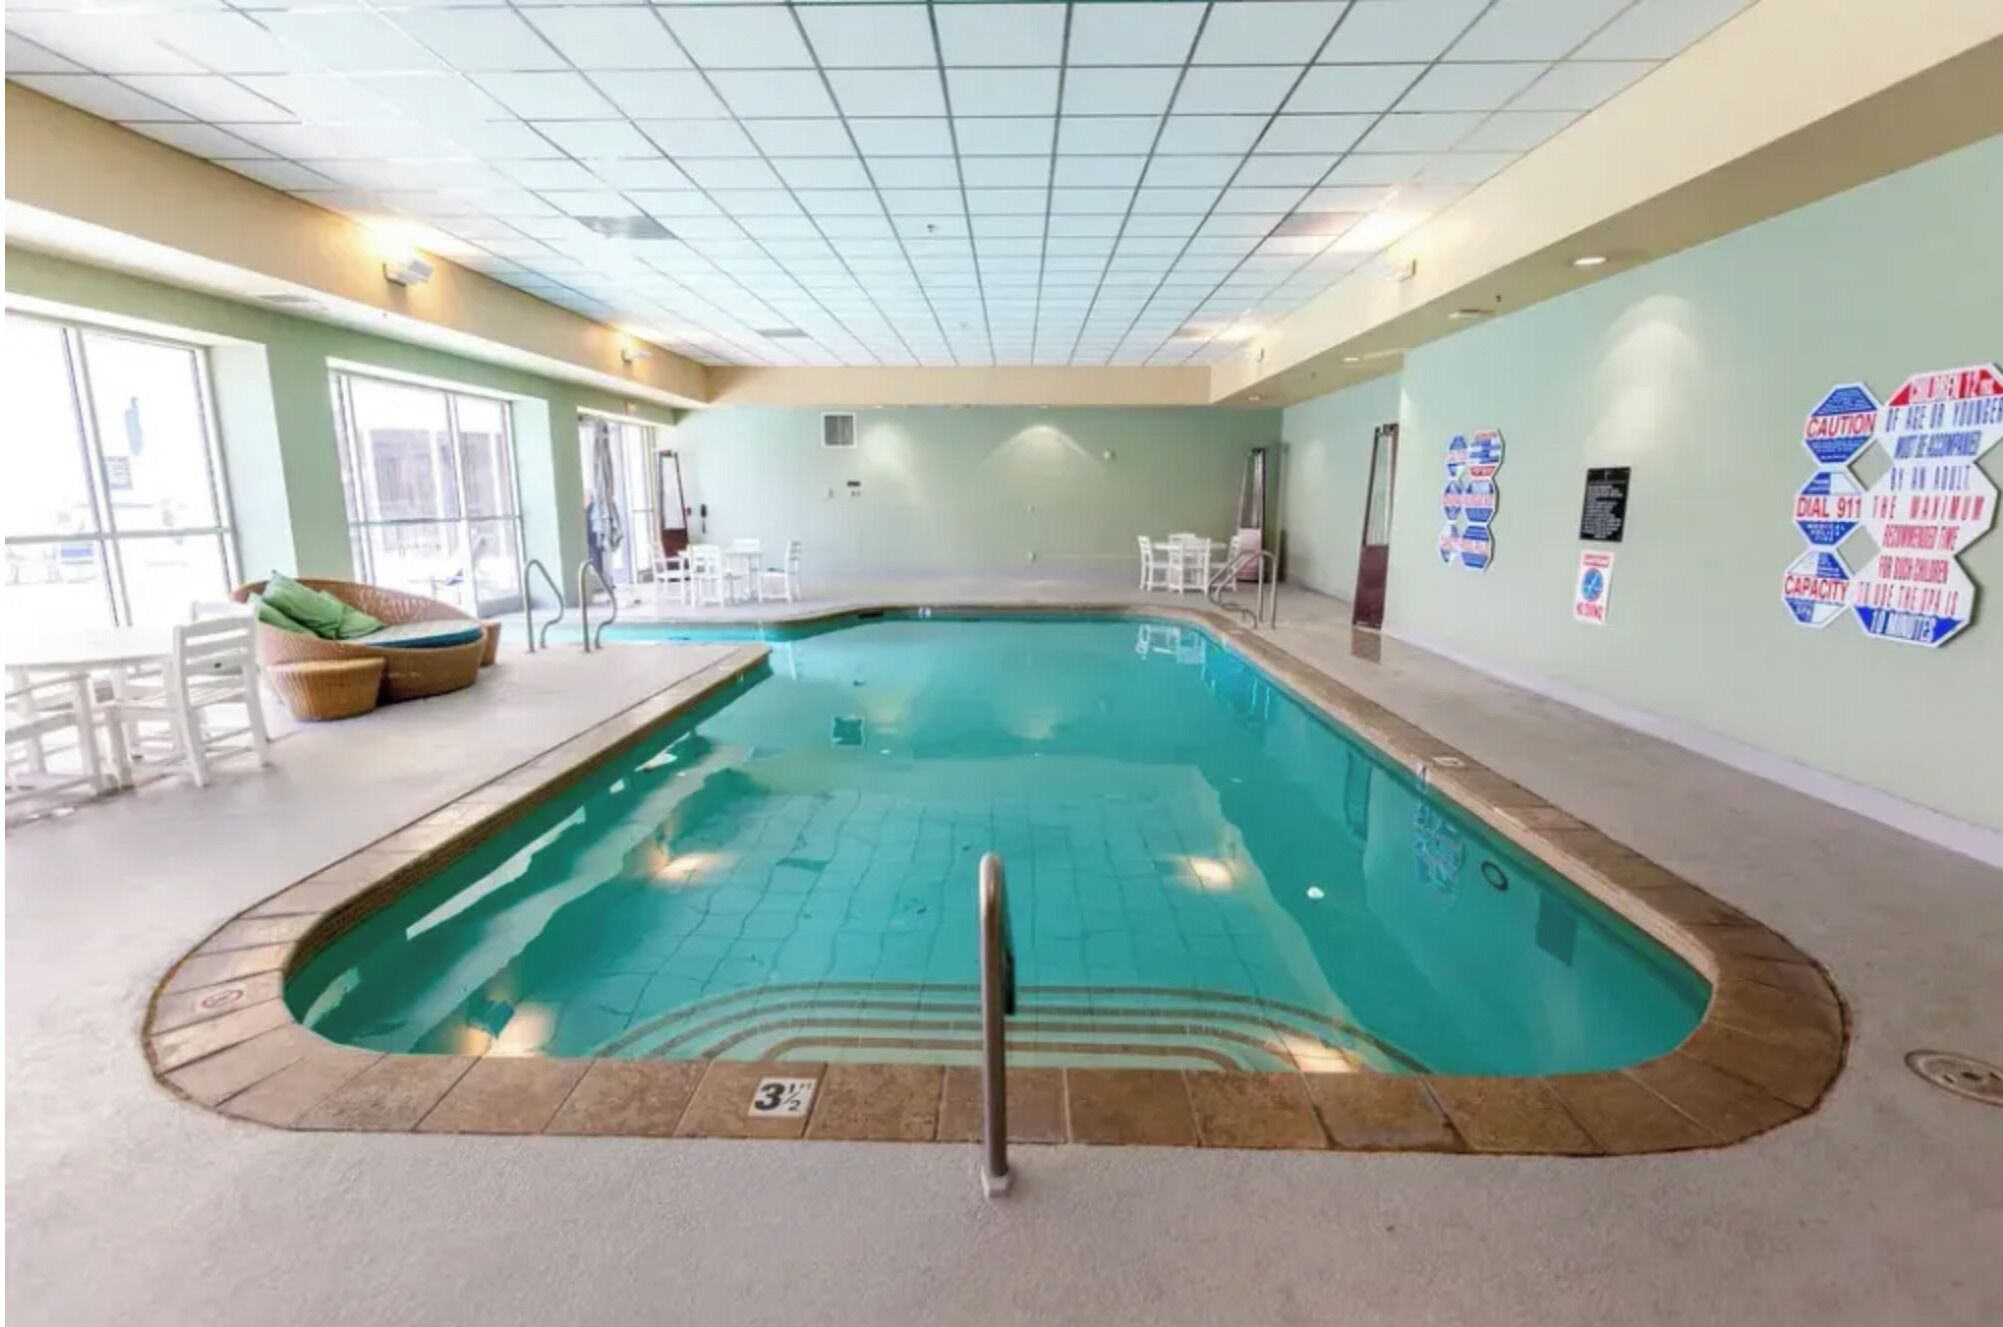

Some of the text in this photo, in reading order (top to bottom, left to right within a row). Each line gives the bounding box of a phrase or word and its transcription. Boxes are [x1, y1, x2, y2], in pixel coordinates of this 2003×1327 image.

[1806, 413, 1877, 438] CAUTION
[1886, 407, 1900, 432] OF
[1905, 405, 1927, 430] AGE
[1911, 467, 1926, 491] AN
[1797, 497, 1862, 519] DIAL 911
[1873, 495, 1985, 521] THE MAXIMUM
[1784, 575, 1850, 602] CAPACITY
